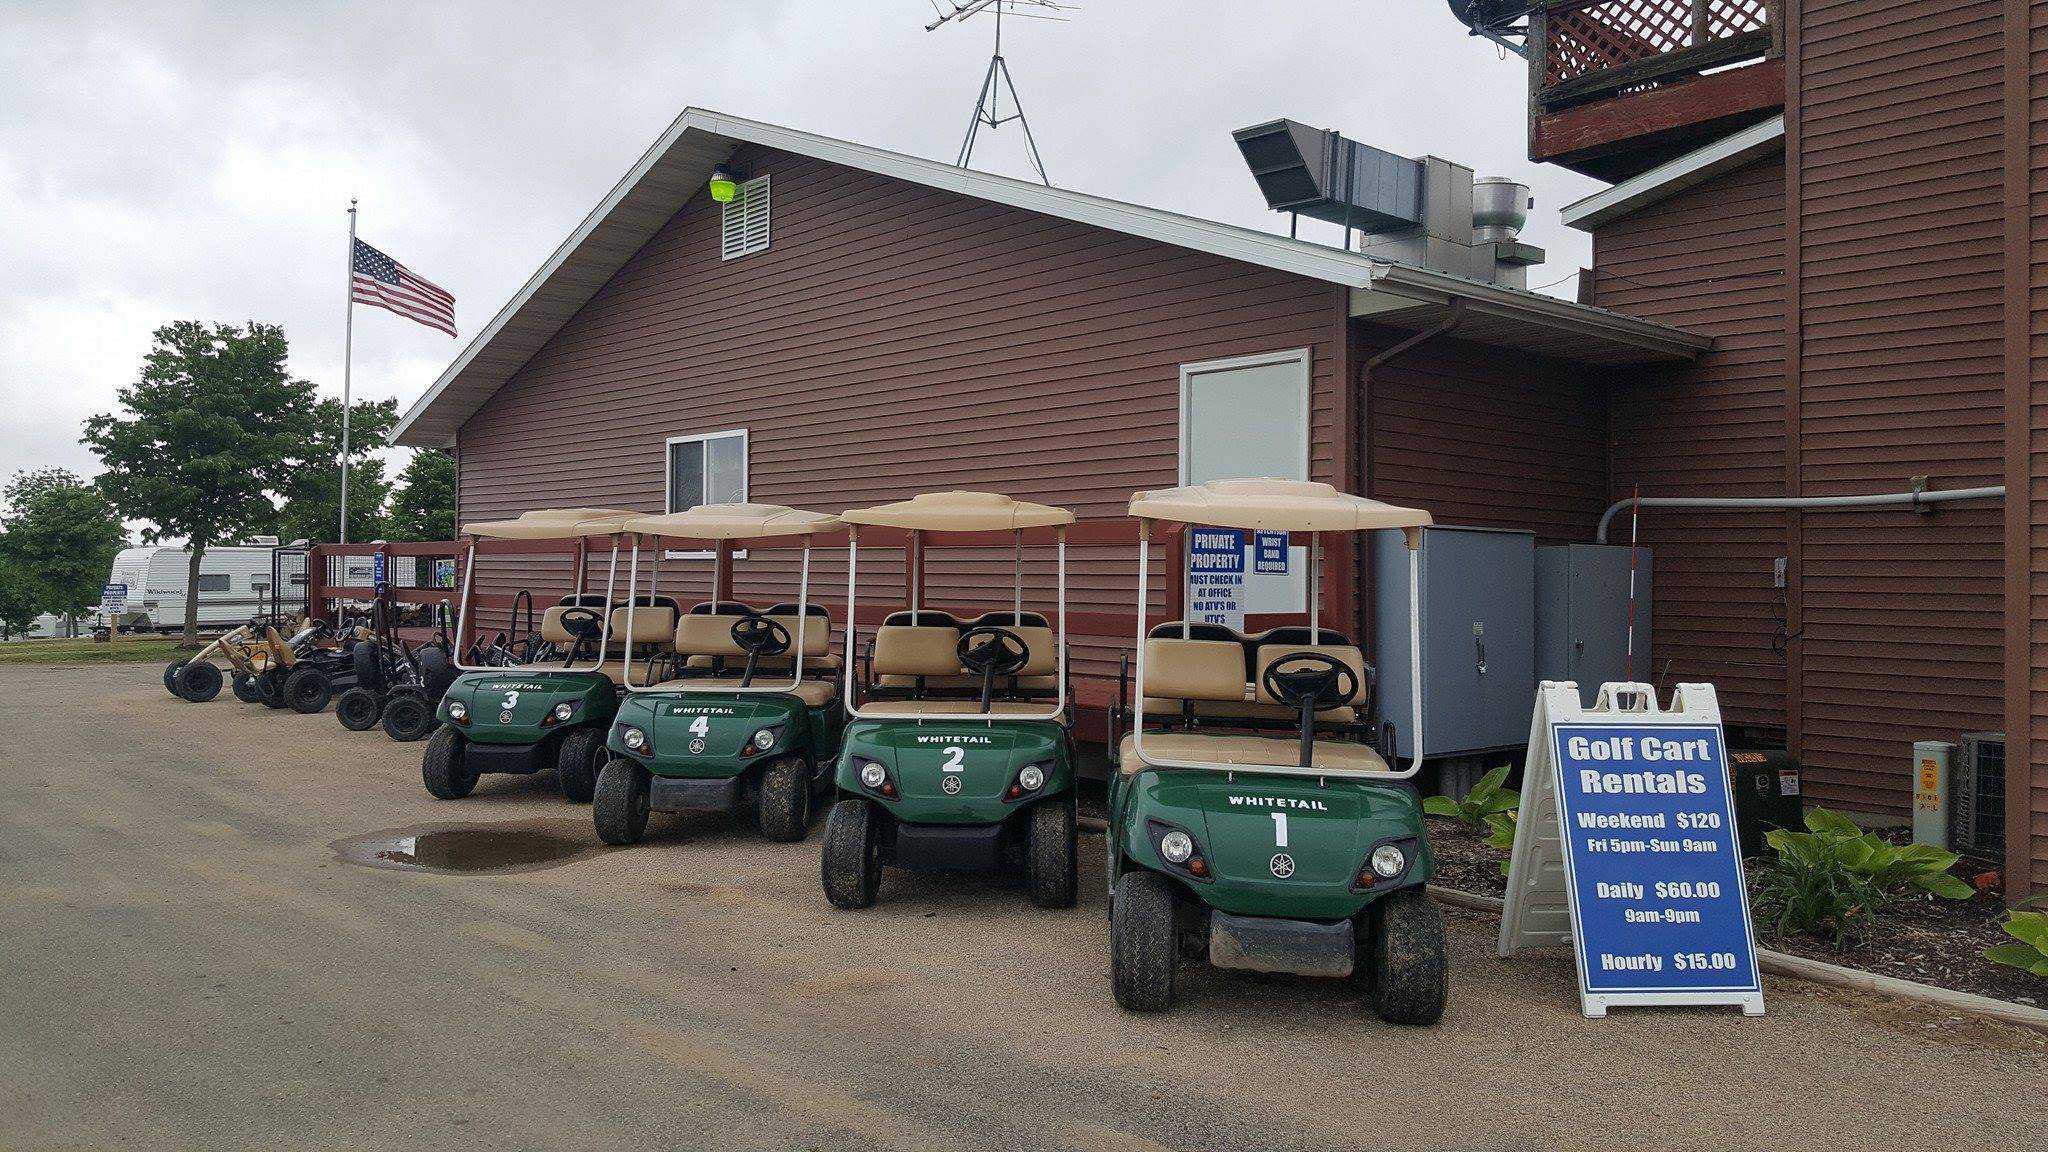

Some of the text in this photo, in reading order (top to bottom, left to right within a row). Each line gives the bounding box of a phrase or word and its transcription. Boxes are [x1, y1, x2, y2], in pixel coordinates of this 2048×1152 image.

[1195, 534, 1235, 549] PRIVATE
[1262, 537, 1282, 547] WRIST
[1190, 553, 1240, 569] PROPERTY
[1264, 550, 1280, 559] BAND
[1257, 562, 1286, 571] REQUIRED
[1210, 575, 1234, 585] CHECK
[1235, 575, 1243, 585] IN
[1198, 588, 1232, 598] AT OFFICE
[1194, 602, 1204, 611] NO
[1226, 602, 1237, 611] OR
[501, 690, 520, 709] 3
[689, 716, 710, 738] 4
[917, 736, 992, 744] WHITETAIL
[1568, 736, 1634, 761] Golf
[1640, 736, 1711, 761] Cart
[942, 746, 965, 772] 2
[1580, 769, 1707, 794] Rentals
[1228, 796, 1328, 811] WHITETAIL
[1577, 811, 1721, 829] Weekend $120
[1270, 812, 1288, 847] 1
[1587, 838, 1718, 853] Fri 5pm-Sun 9am
[1596, 881, 1720, 900] Daily $60.00
[1624, 908, 1701, 924] 9am-9pm
[1601, 952, 1737, 972] Hourly $15.00
